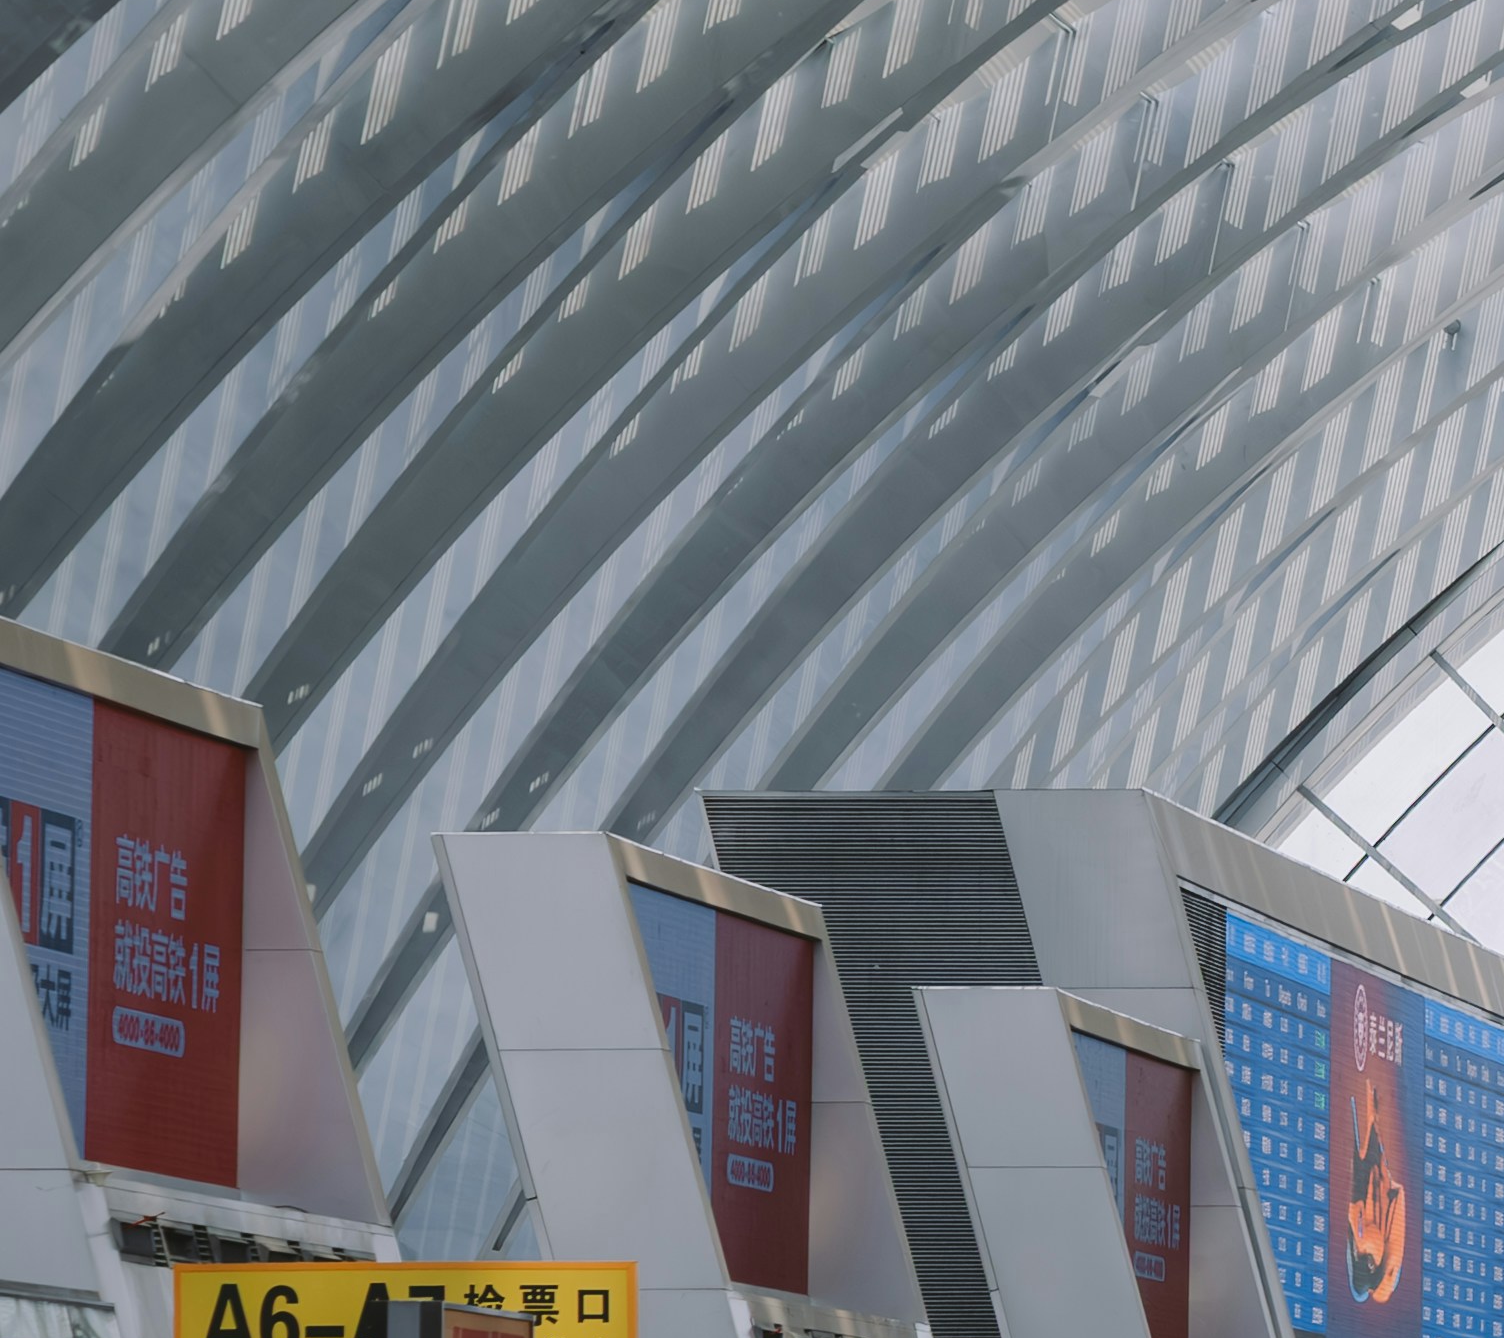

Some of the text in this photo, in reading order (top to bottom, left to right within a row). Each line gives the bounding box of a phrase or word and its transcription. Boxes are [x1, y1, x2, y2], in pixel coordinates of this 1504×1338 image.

[116, 834, 188, 921] 高铁广告
[729, 1016, 776, 1082] 高铁广告
